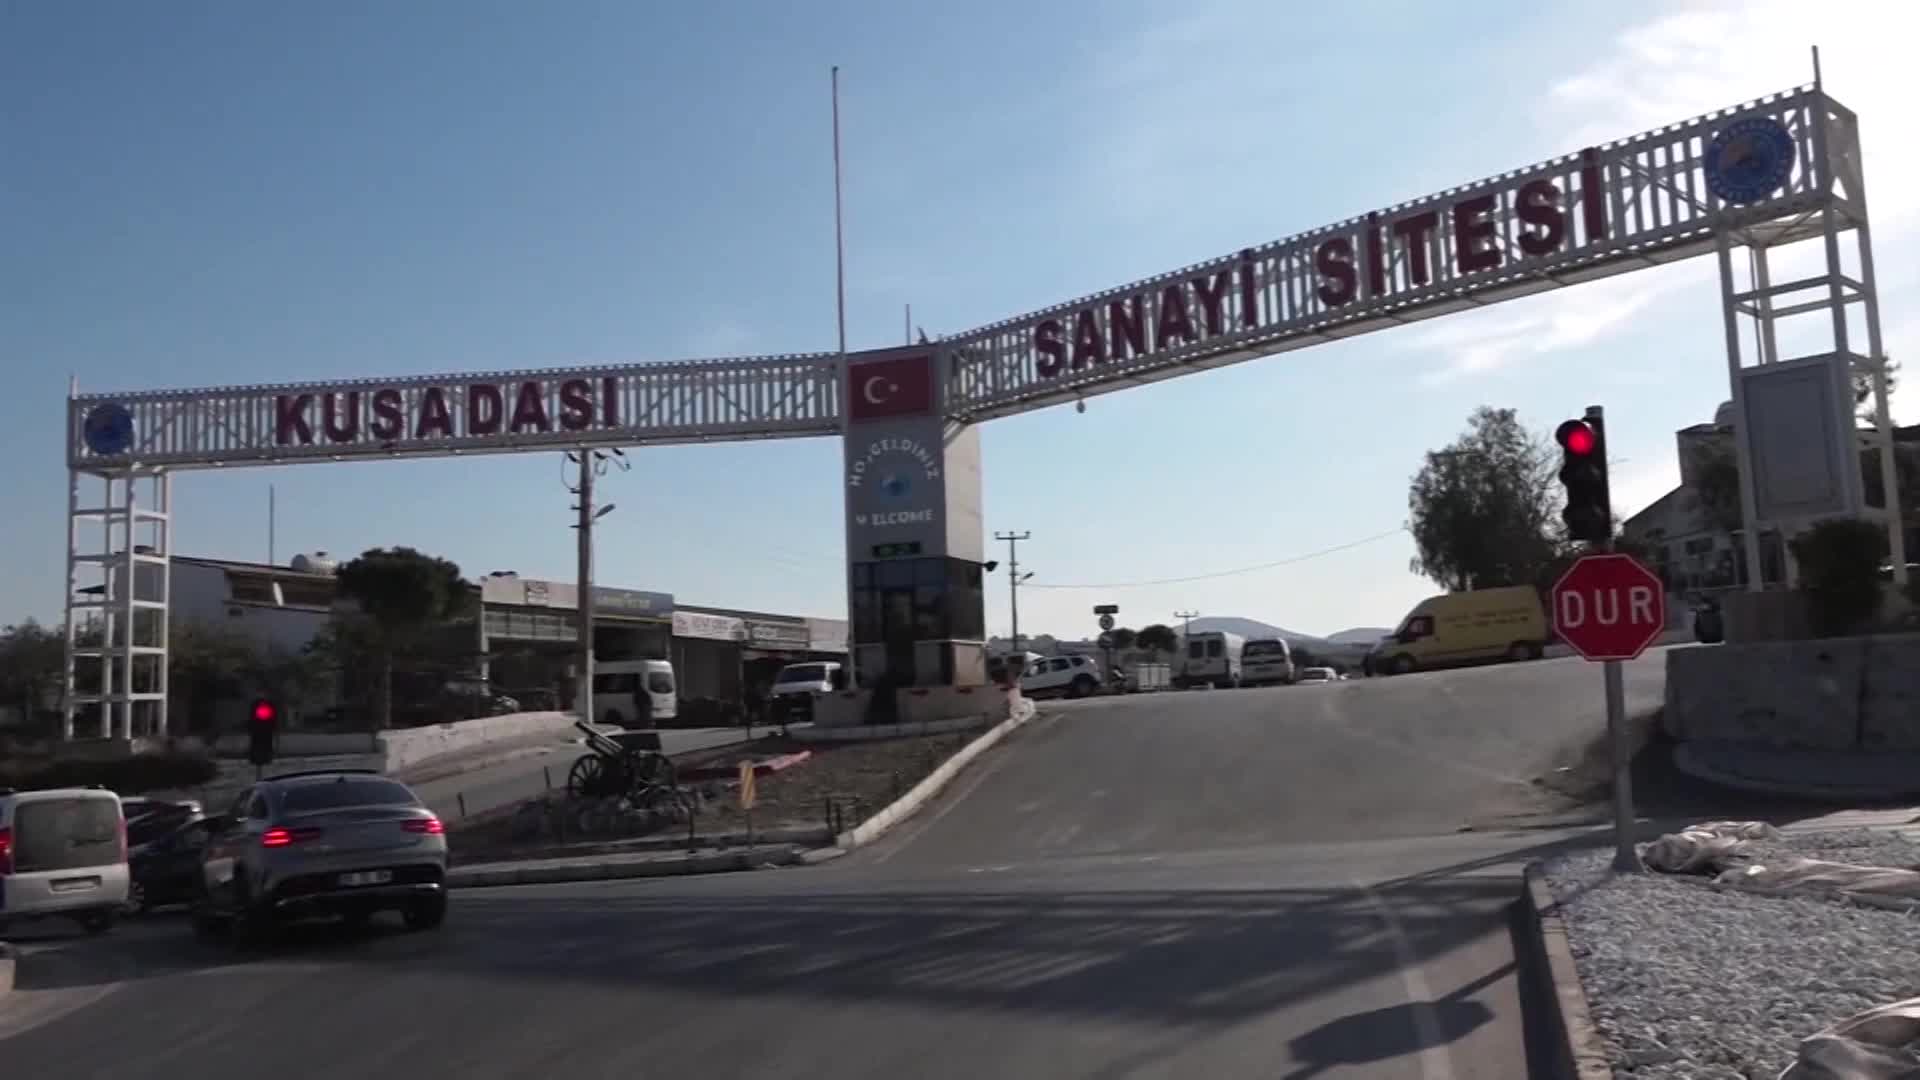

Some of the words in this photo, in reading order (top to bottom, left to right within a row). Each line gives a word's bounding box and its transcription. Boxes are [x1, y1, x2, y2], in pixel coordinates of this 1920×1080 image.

[1034, 249, 1257, 379] SANAYİ
[1316, 147, 1607, 306] SİTESİ
[1561, 585, 1655, 629] DUR
